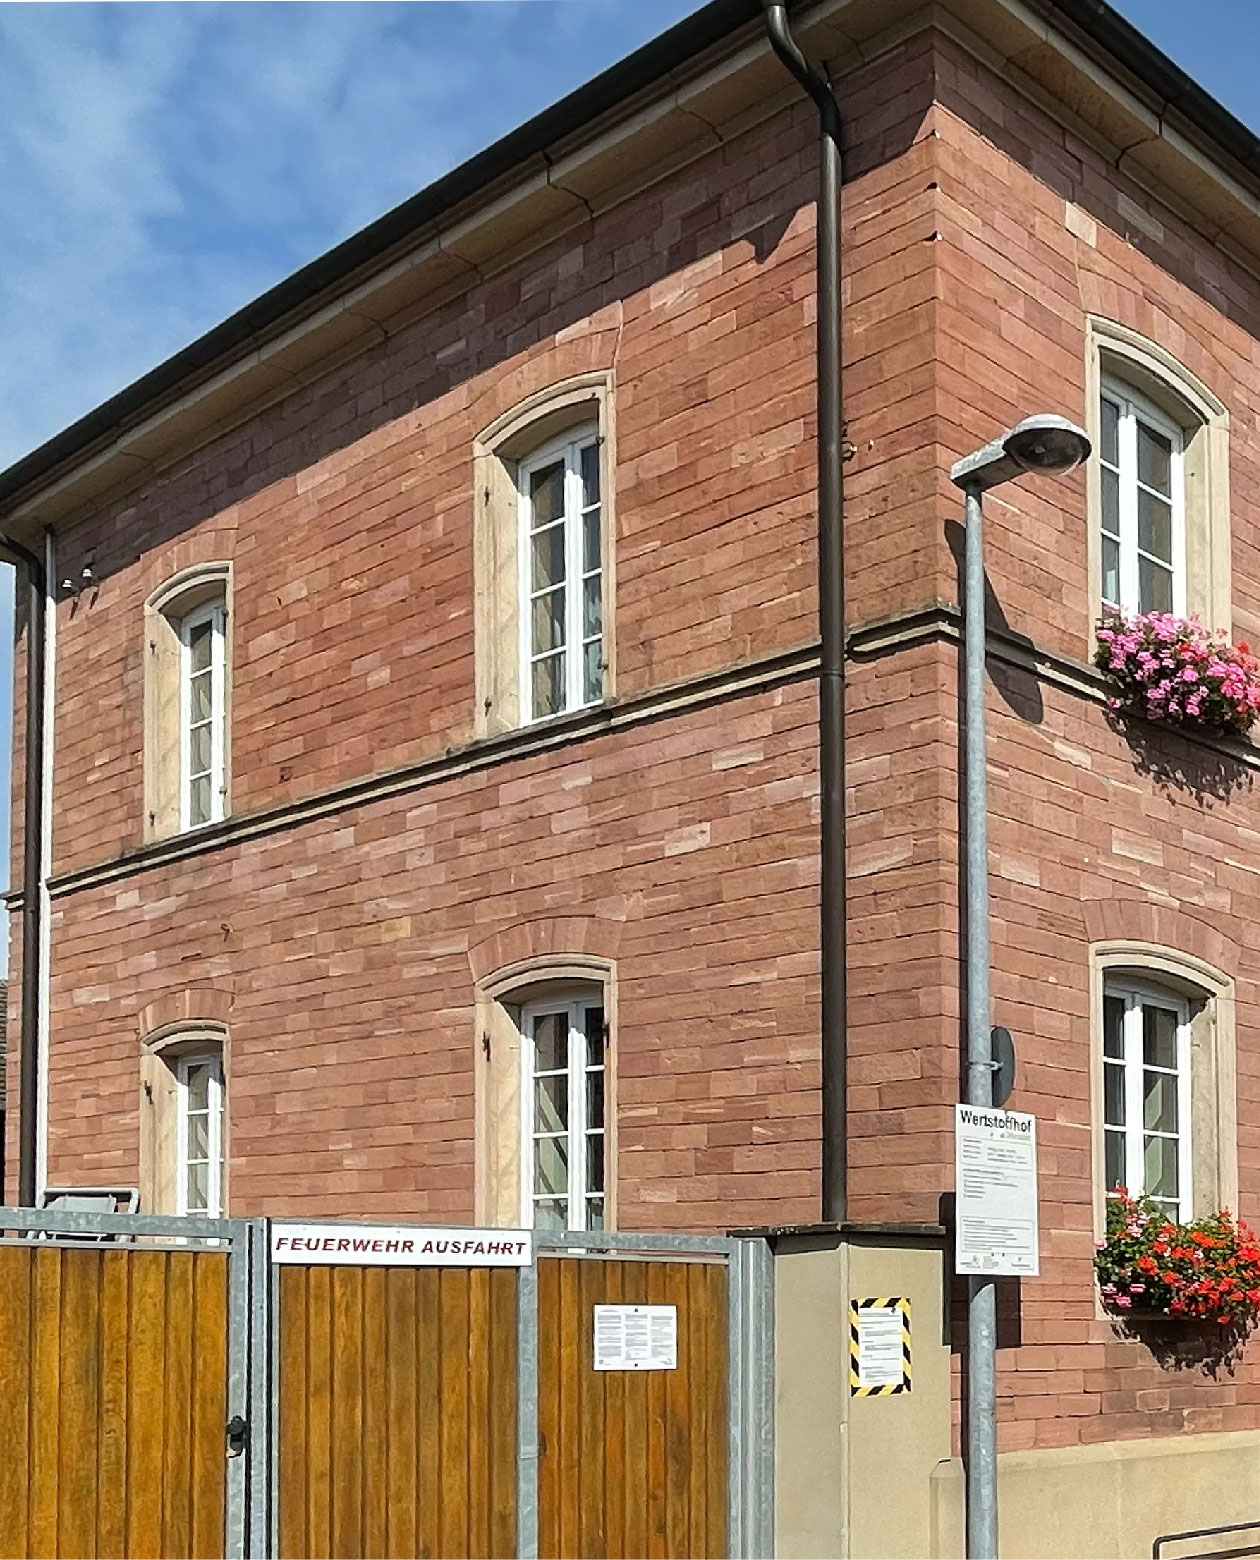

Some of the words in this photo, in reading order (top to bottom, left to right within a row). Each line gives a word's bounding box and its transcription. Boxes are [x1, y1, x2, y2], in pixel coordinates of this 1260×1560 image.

[960, 1109, 1032, 1133] Wertstoffhof
[275, 1237, 414, 1253] FEUERWEHR
[421, 1240, 526, 1255] AUSFAHRT
